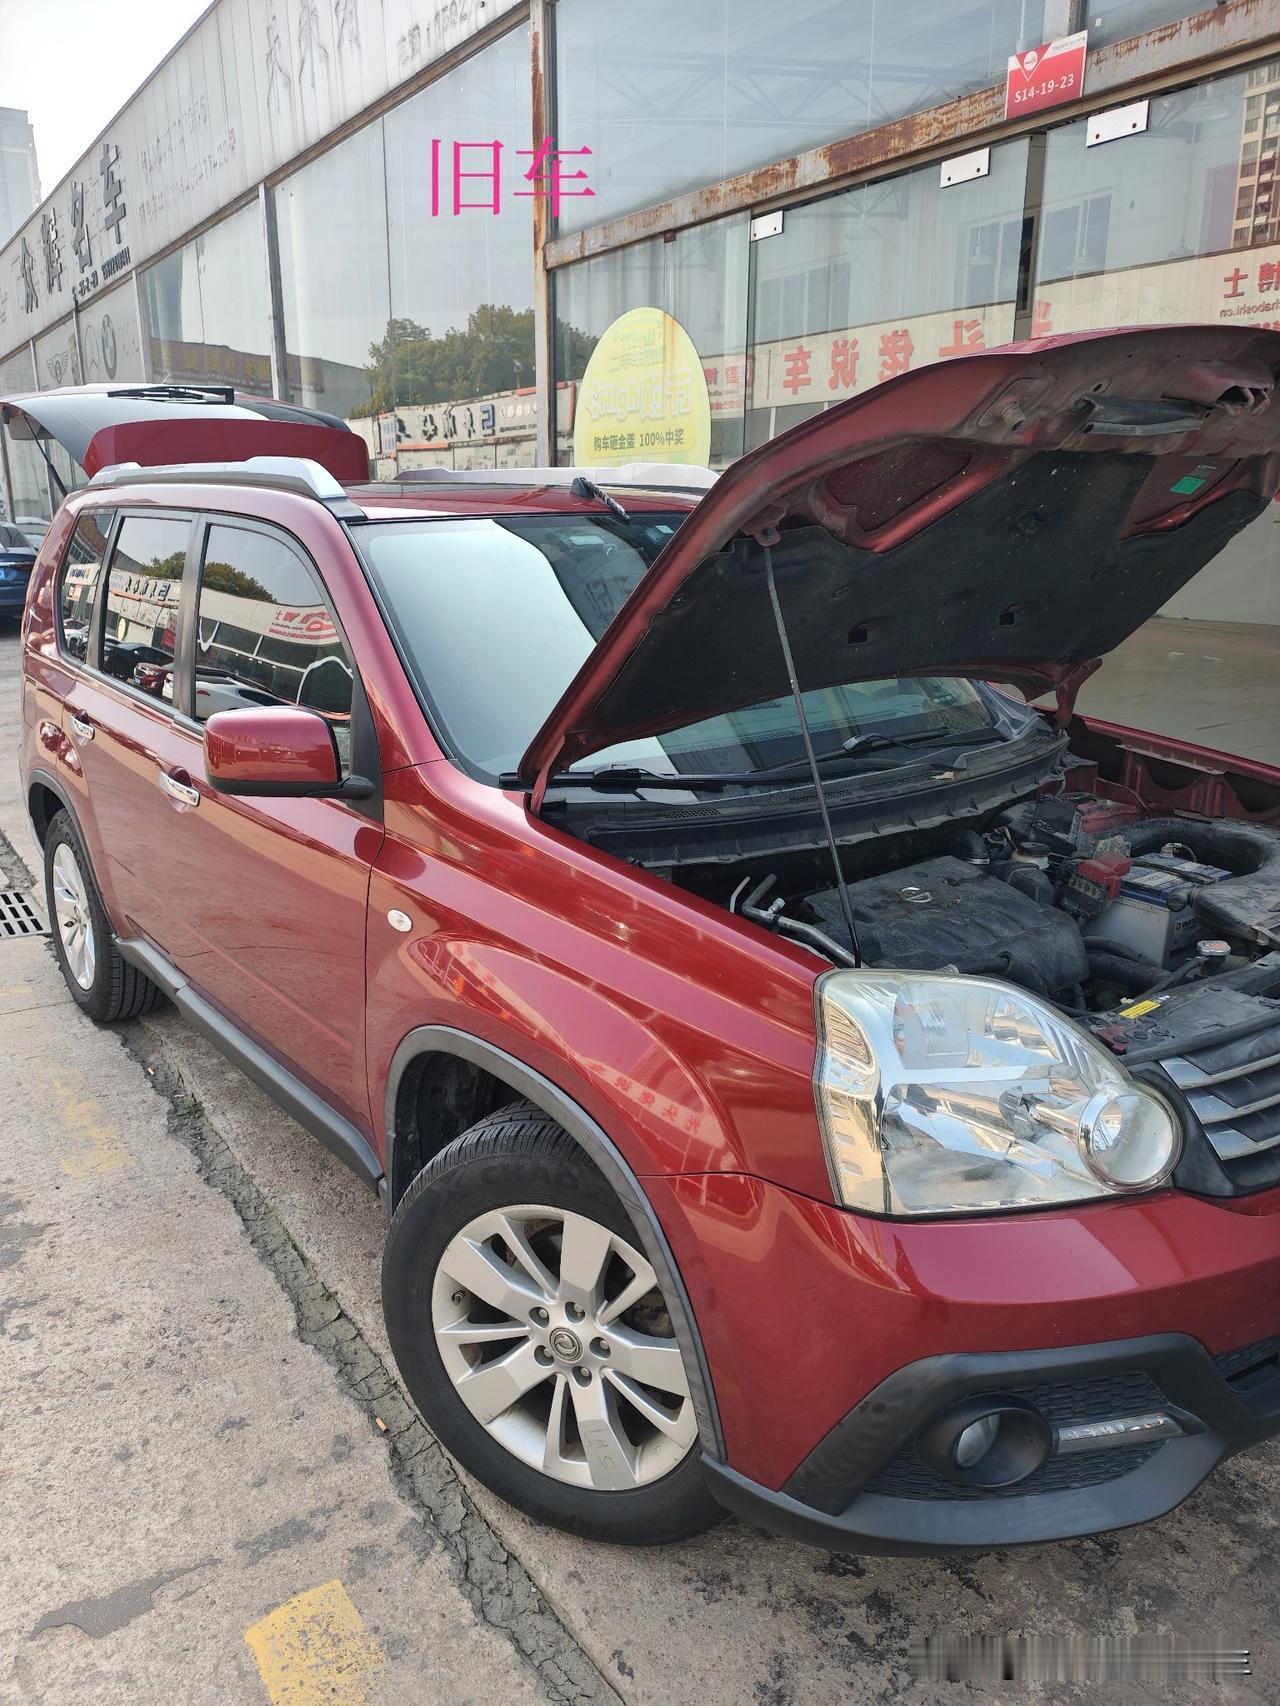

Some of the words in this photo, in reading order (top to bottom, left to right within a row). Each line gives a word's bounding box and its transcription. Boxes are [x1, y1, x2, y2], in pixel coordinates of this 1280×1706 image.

[1014, 73, 1074, 103] S14-19-23
[593, 432, 635, 452] 购车砸金蛋
[640, 427, 684, 447] 100%中奖
